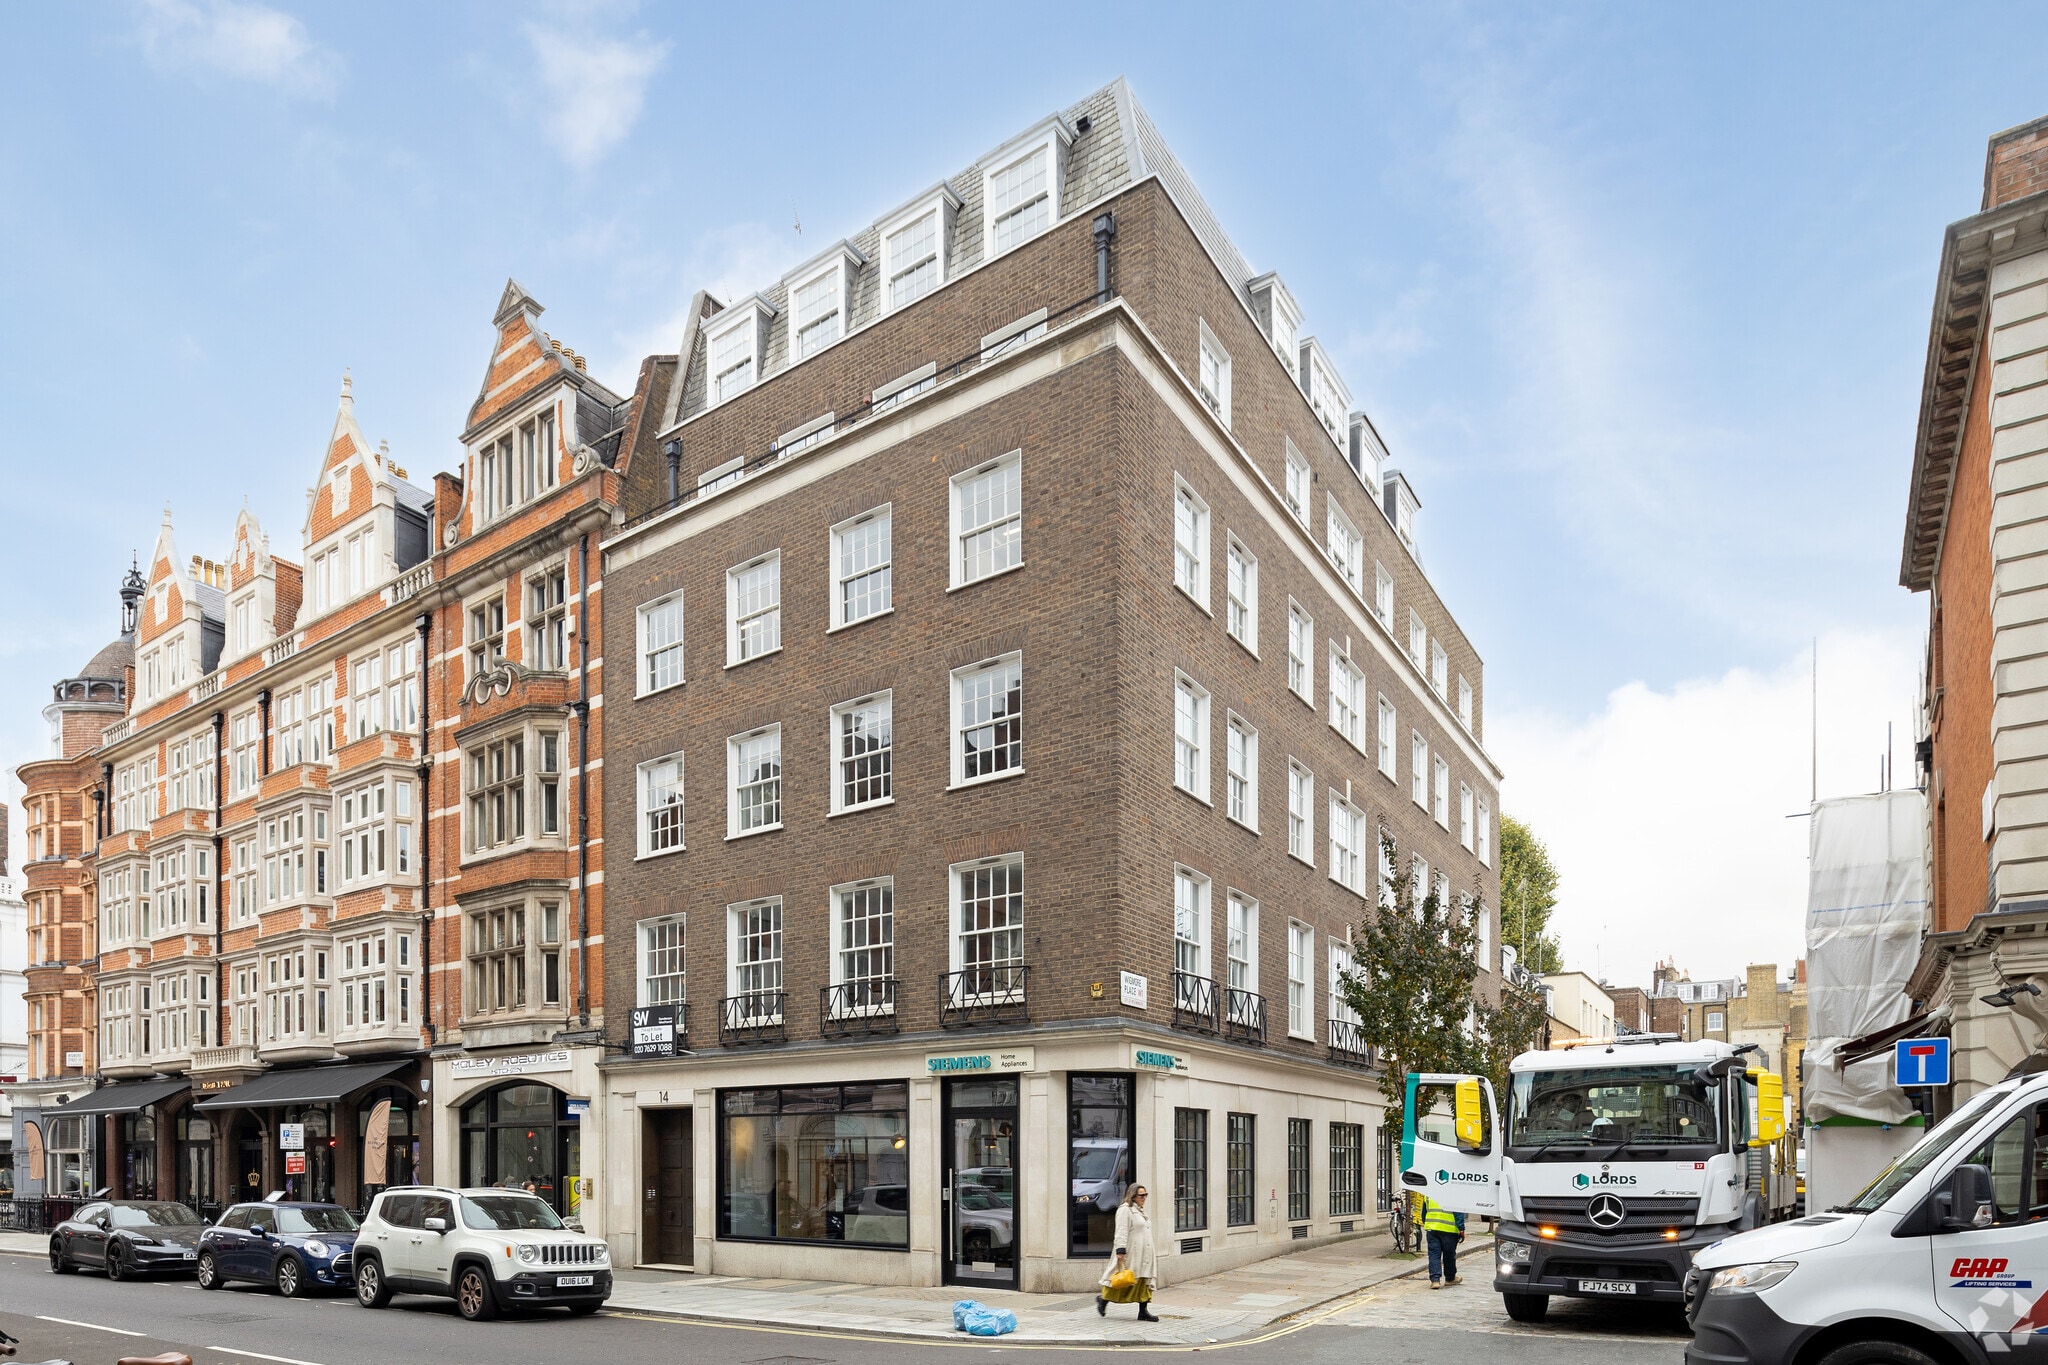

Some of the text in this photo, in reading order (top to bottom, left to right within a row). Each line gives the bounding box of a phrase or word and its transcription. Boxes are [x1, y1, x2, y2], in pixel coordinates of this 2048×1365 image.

[1124, 976, 1142, 988] WIGMORE
[1124, 985, 1136, 996] PLACE
[634, 1011, 649, 1026] SW
[641, 1032, 662, 1042] To Let
[634, 1043, 672, 1054] 020 7629 1088
[452, 1052, 568, 1070] MOLEY ROBOTICS
[928, 1055, 991, 1071] SIEMENS
[1136, 1050, 1174, 1068] SIEMENS
[659, 1090, 668, 1103] 14
[1452, 1172, 1488, 1182] LORDS
[1592, 1176, 1636, 1184] LORDS
[1950, 1258, 2008, 1278] GAP
[1582, 1282, 1631, 1292] FJ74 SCX
